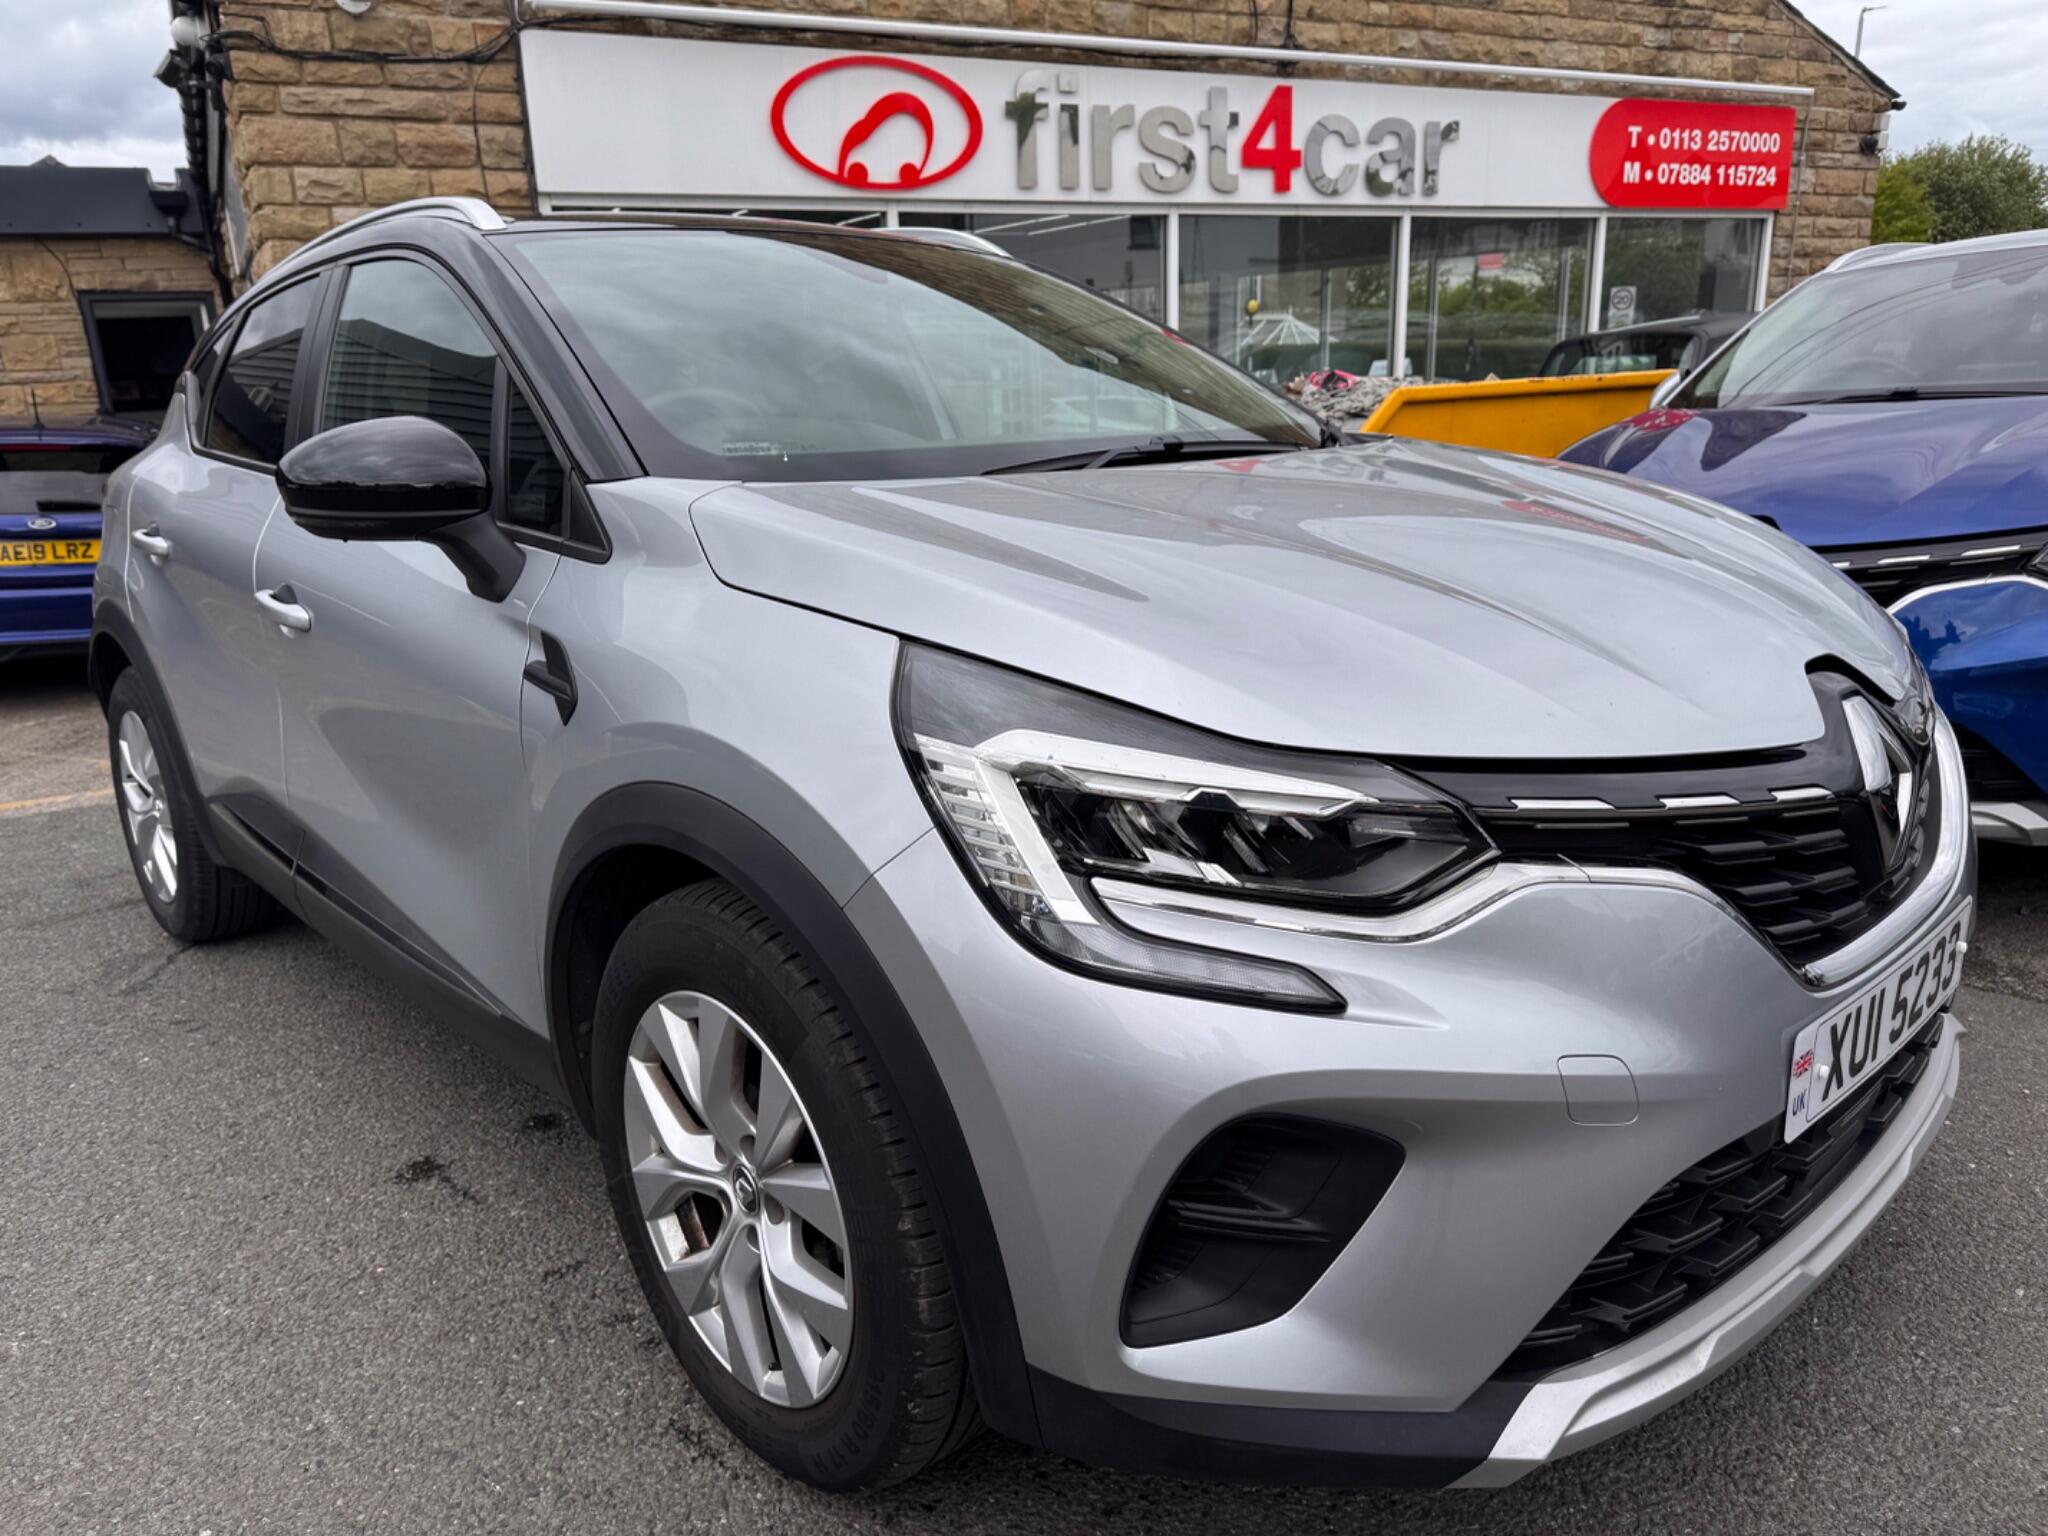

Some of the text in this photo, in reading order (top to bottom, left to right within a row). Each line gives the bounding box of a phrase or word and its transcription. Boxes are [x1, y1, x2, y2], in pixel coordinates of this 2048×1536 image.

[1005, 69, 1460, 197] first4car
[1659, 128, 1702, 151] 0113
[1706, 129, 1780, 153] 2570000
[1657, 163, 1711, 185] 07884
[1716, 165, 1777, 186] 115724
[0, 542, 94, 561] AE19 LRZ
[1822, 920, 1962, 1102] XUI 5233
[1792, 1088, 1806, 1117] UK
